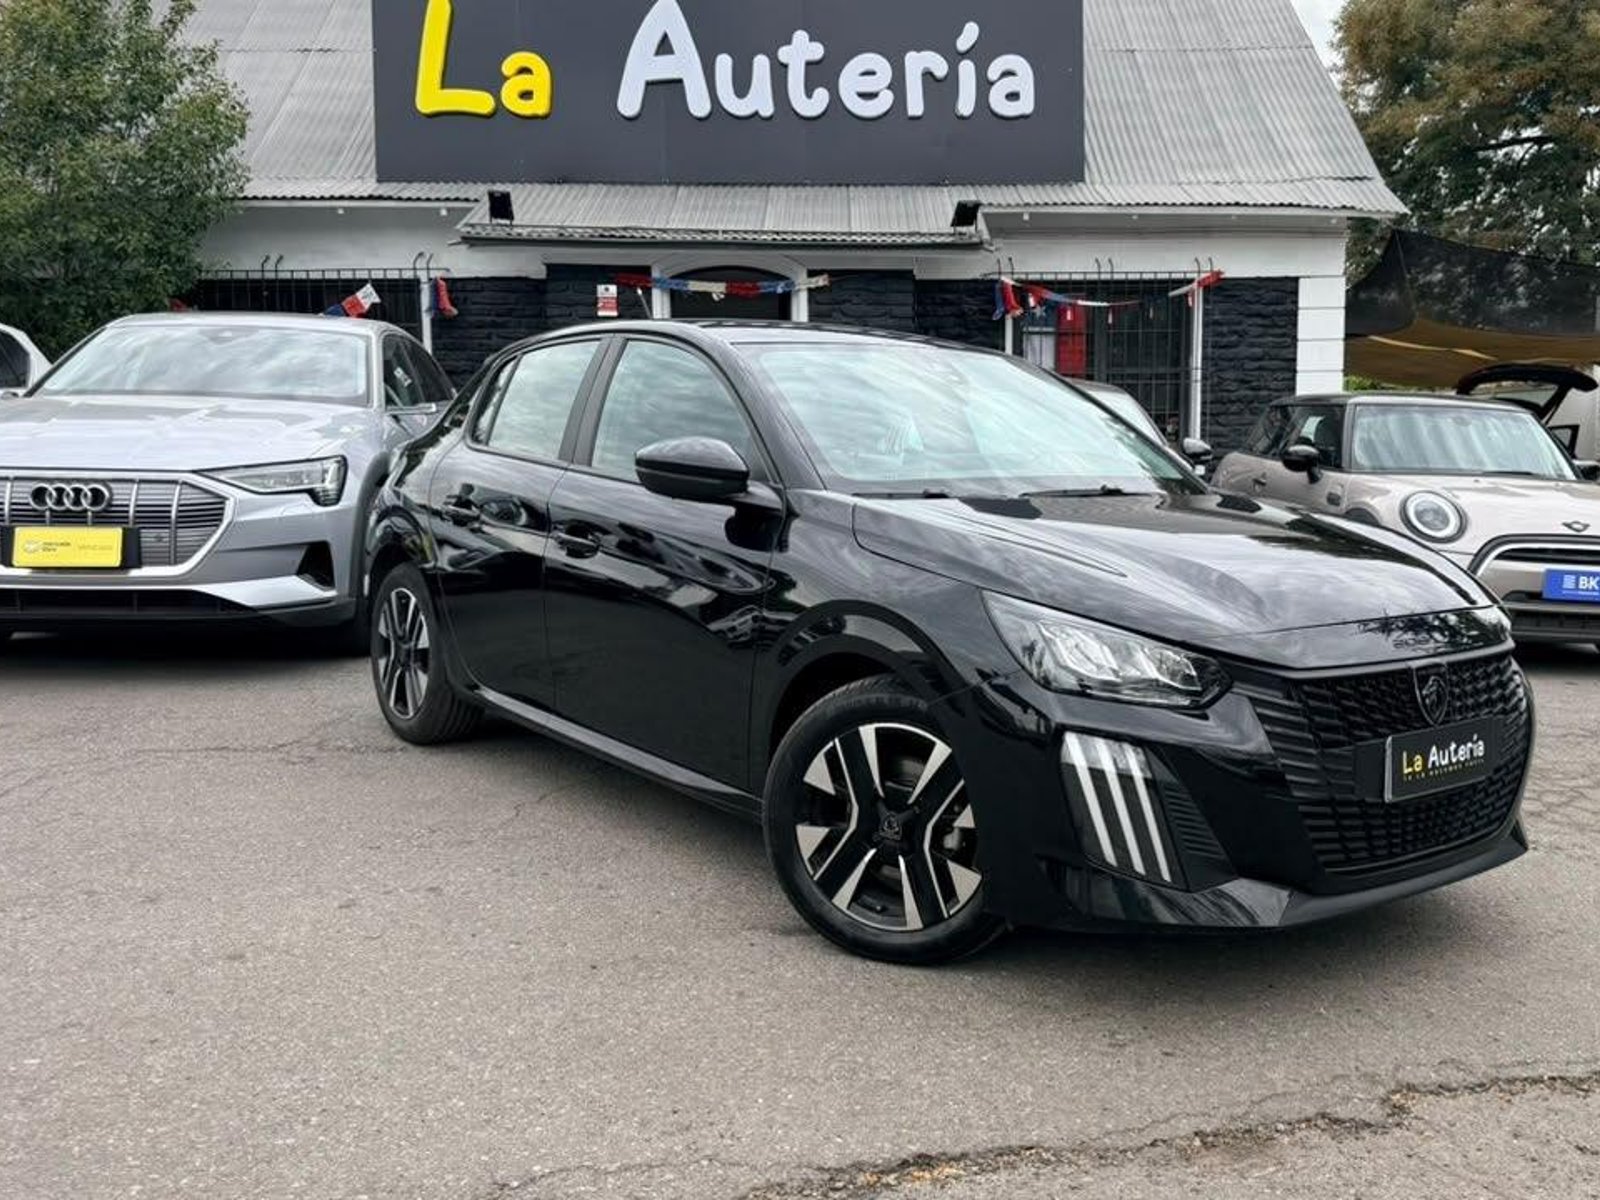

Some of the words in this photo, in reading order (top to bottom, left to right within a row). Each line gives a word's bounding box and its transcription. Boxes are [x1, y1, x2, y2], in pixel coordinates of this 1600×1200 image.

[415, 0, 553, 119] La
[616, 0, 1036, 120] Autería
[1402, 750, 1423, 775] La
[1427, 732, 1485, 769] Autería
